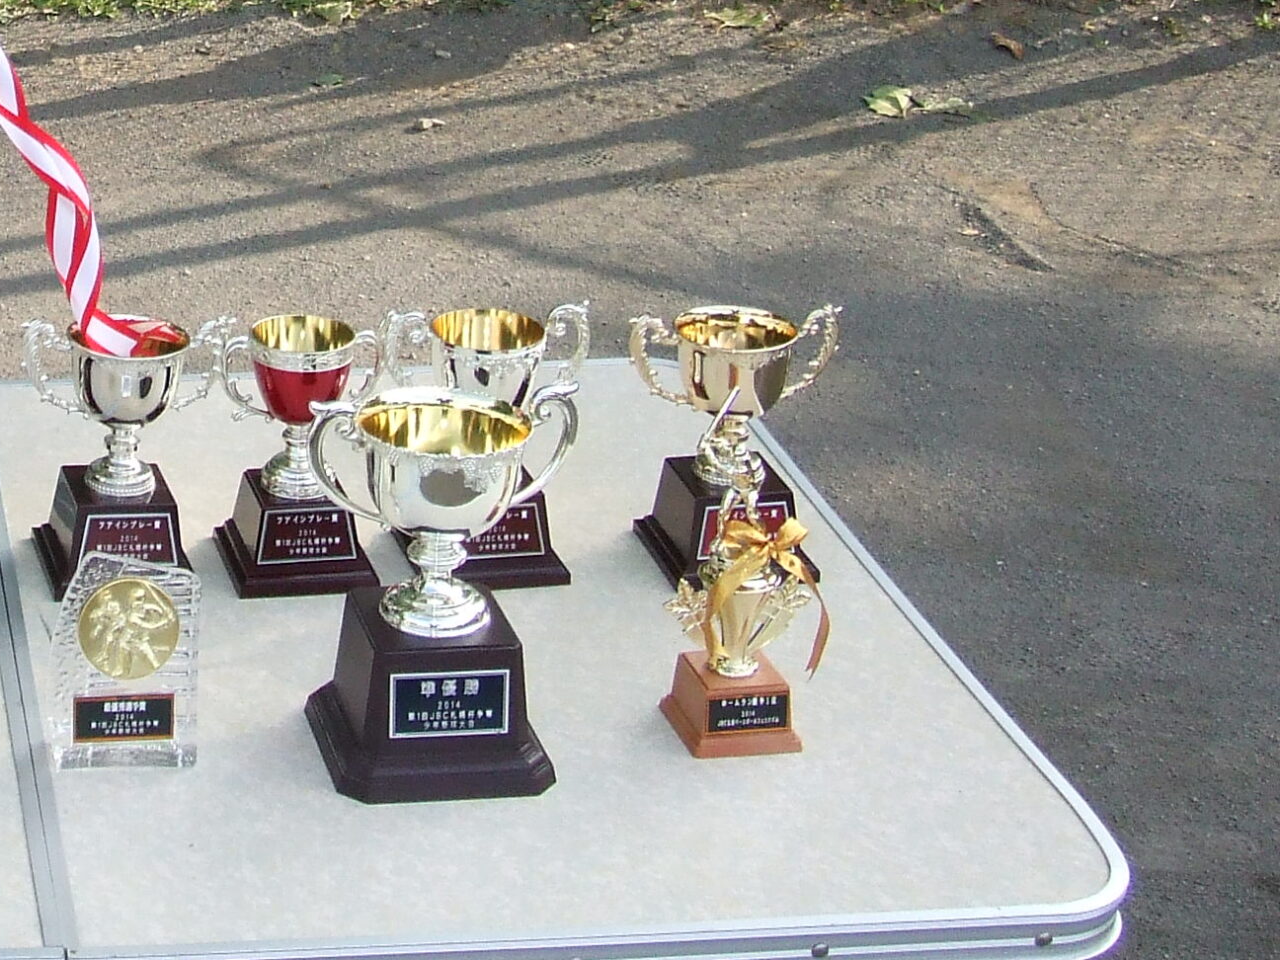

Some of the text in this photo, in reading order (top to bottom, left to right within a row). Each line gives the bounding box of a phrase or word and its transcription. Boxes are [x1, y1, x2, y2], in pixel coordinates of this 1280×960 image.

[420, 679, 480, 698] 準優勝
[437, 701, 461, 709] 2014
